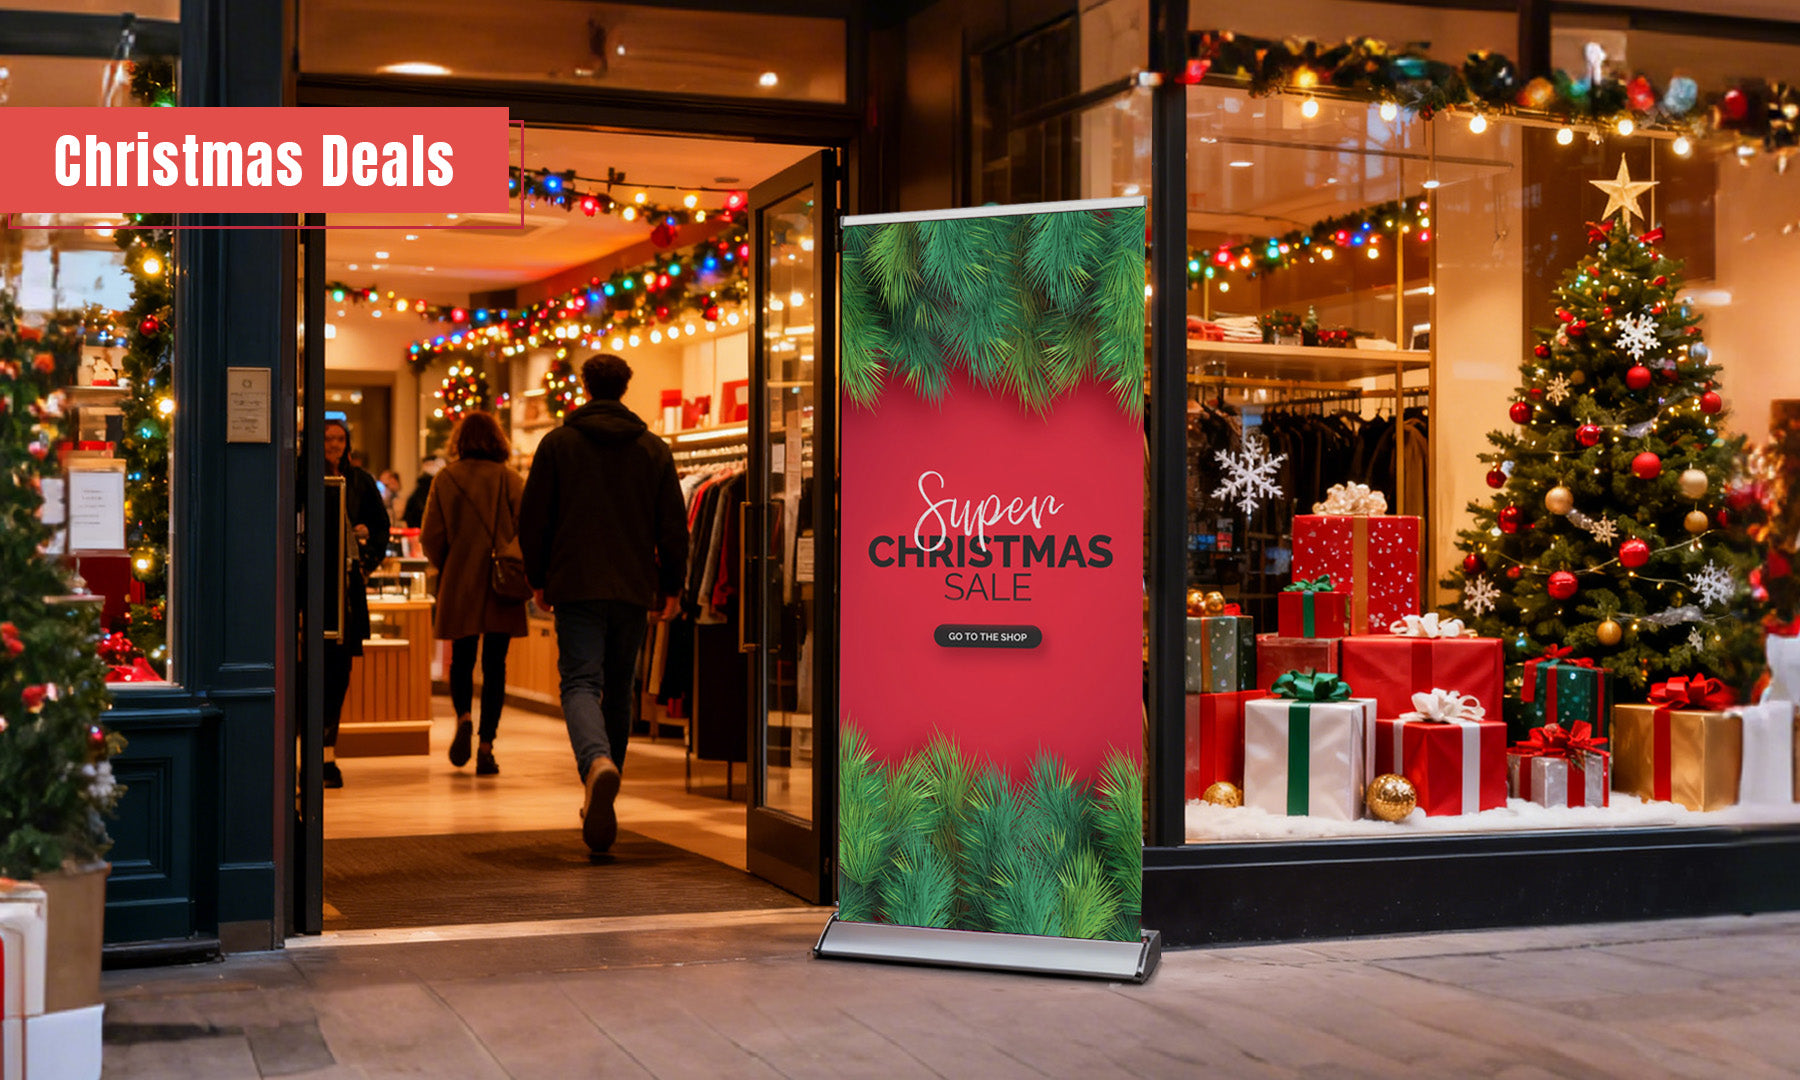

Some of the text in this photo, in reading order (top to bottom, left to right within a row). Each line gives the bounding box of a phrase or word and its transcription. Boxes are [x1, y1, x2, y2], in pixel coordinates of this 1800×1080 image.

[914, 470, 1065, 553] Super
[868, 534, 1114, 569] CHRISTMAS
[944, 573, 1033, 602] SALE
[948, 632, 1028, 642] GO TO THE SHOP
